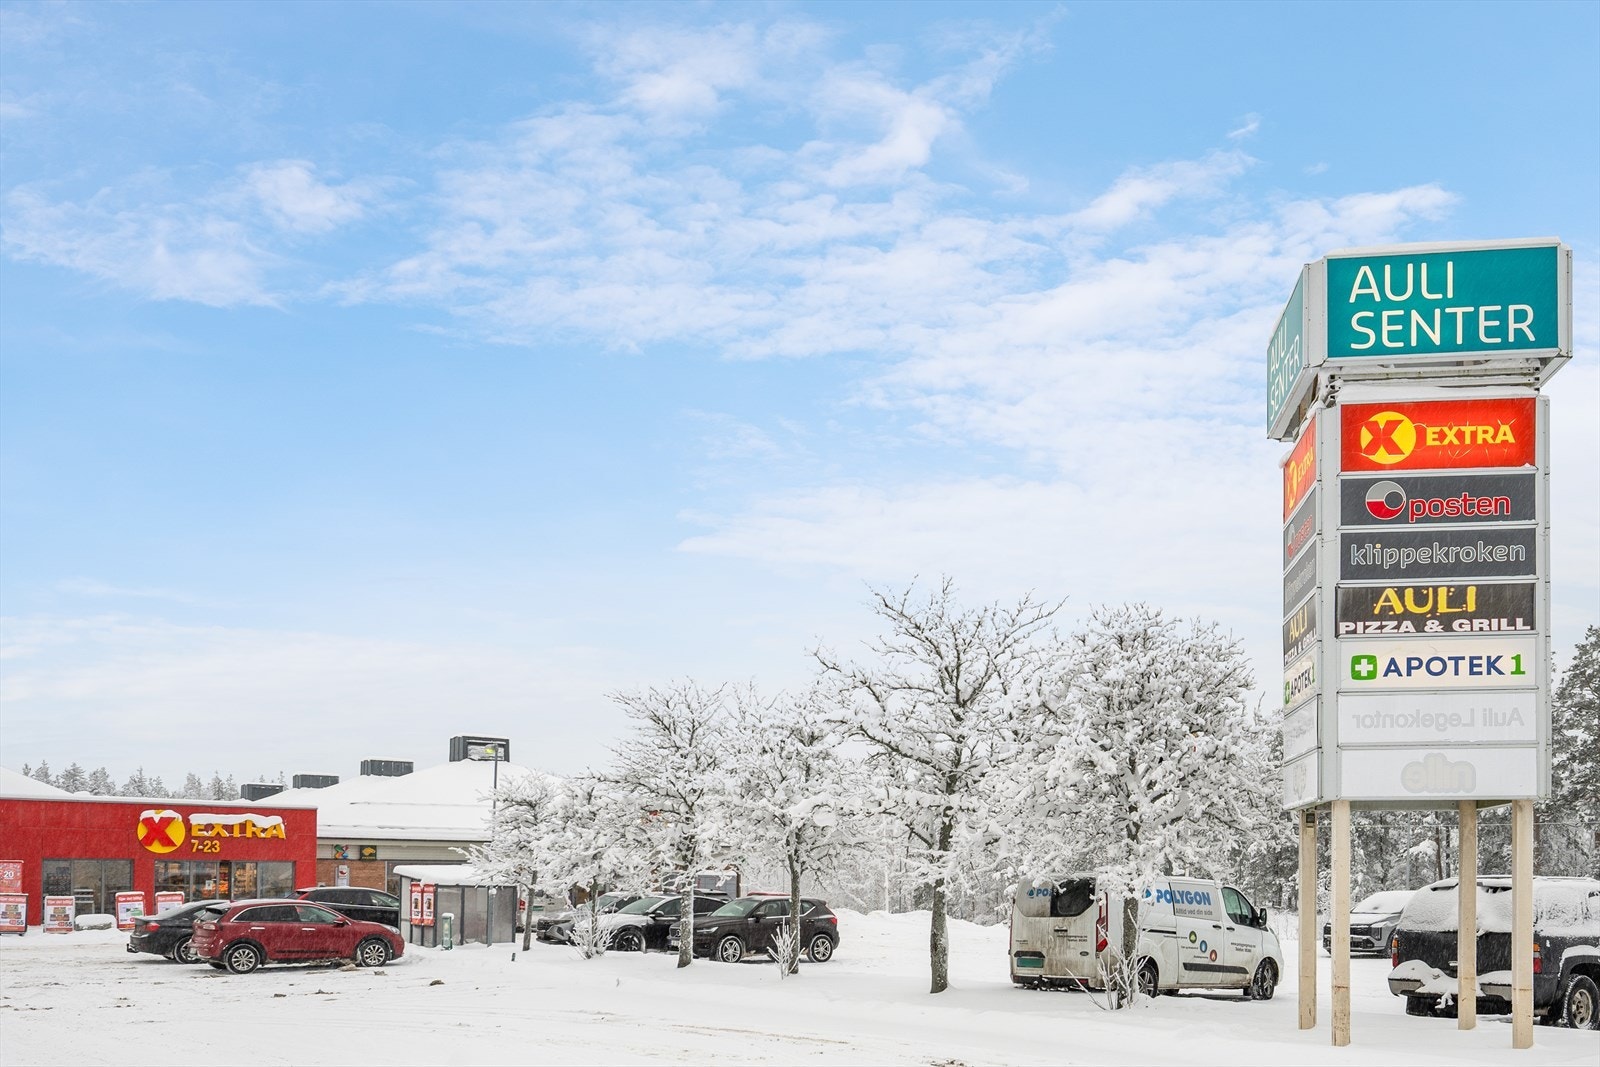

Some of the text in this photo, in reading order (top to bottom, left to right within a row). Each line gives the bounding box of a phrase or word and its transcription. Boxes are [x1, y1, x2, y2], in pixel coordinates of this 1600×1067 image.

[1349, 260, 1454, 303] AULI
[1350, 304, 1536, 350] SENTER
[1270, 317, 1287, 382] AULI
[1270, 334, 1300, 420] SENTER
[1426, 424, 1516, 447] EXTRA
[1408, 491, 1511, 523] posten
[1350, 540, 1526, 570] klippekroken
[1373, 585, 1478, 616] AULI
[1288, 604, 1308, 644] AULI
[1339, 617, 1531, 634] PIZZA & GRILL
[1290, 661, 1316, 697] APOTEK 1
[1383, 653, 1526, 678] APOTEK 1
[191, 840, 220, 853] 7-23
[1156, 889, 1212, 906] POLYGON
